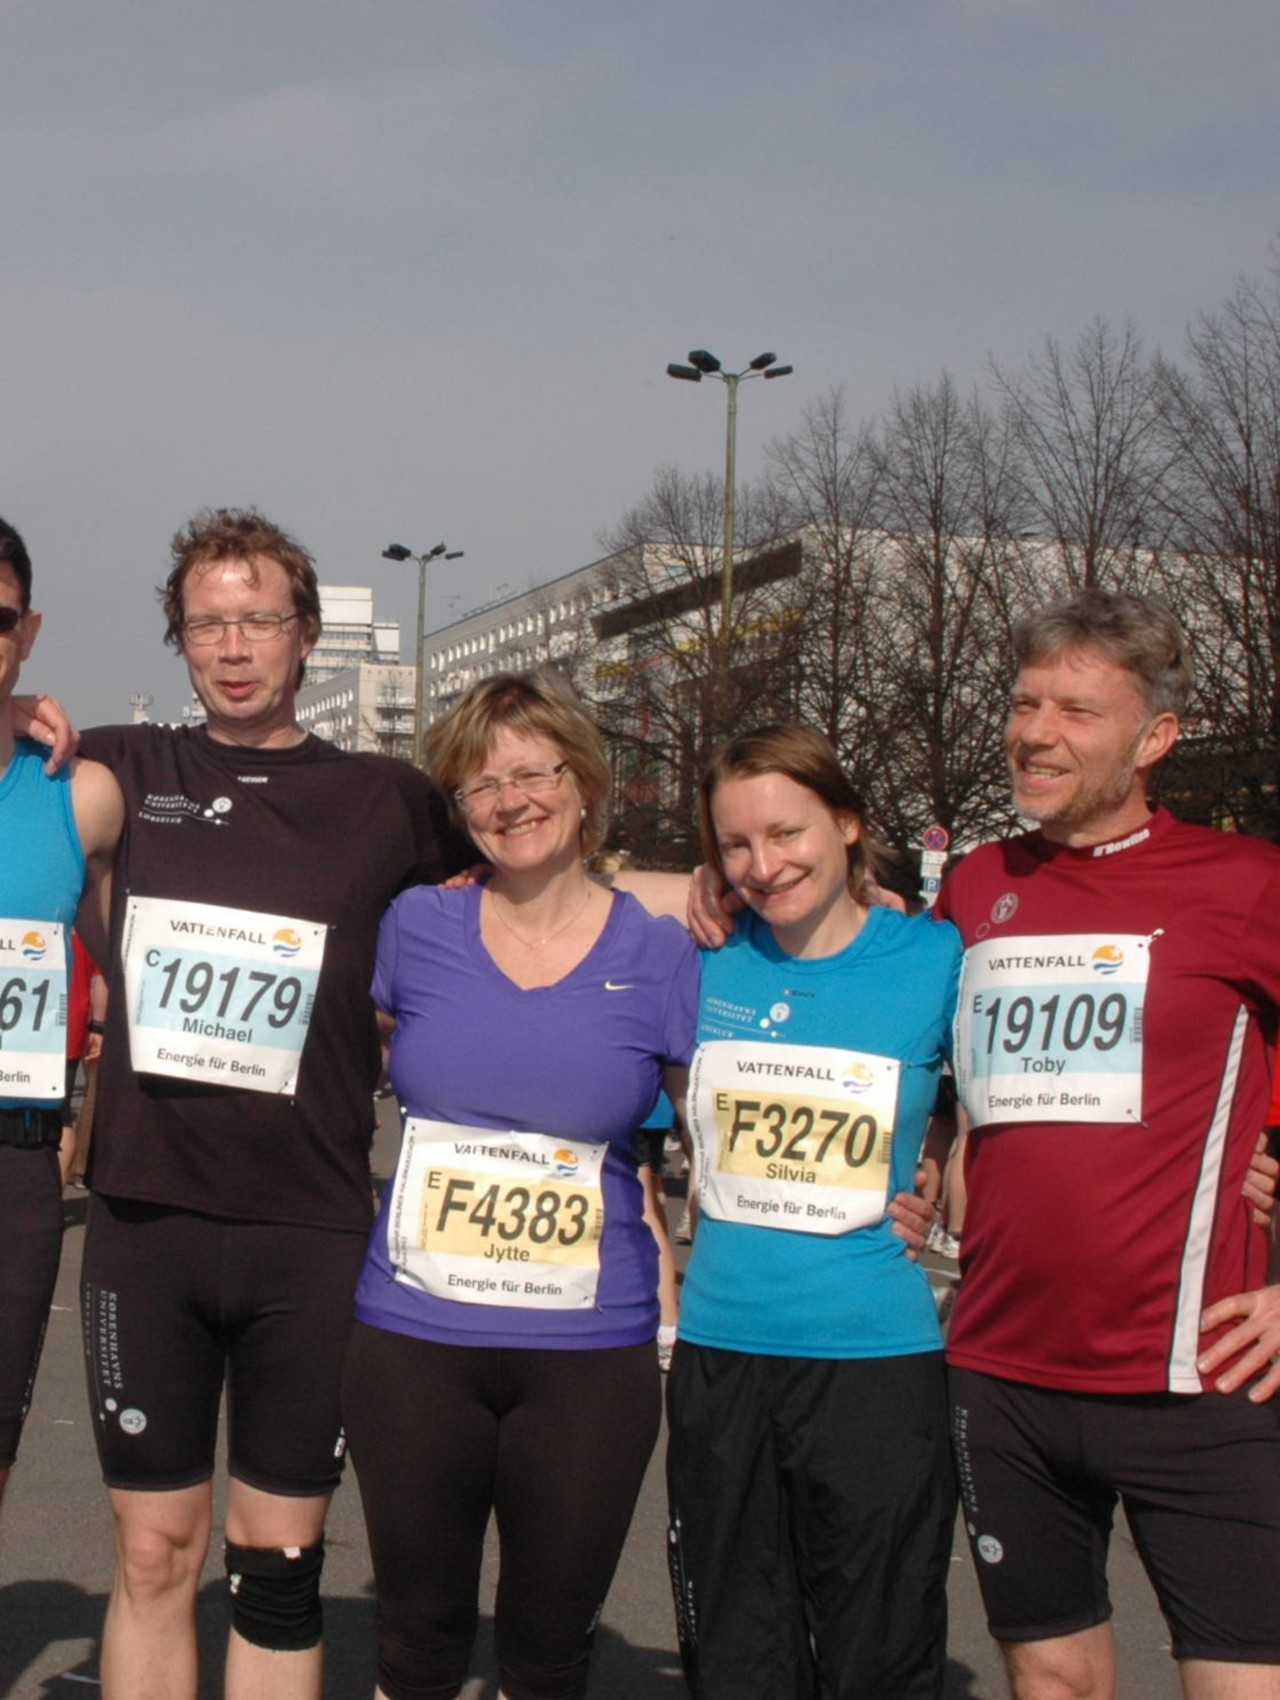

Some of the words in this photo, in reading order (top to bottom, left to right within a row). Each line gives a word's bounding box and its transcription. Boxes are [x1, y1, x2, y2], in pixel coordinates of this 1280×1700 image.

[170, 919, 267, 945] VATTENFALL
[146, 949, 161, 968] C
[989, 955, 1086, 971] VATTENFALL
[159, 957, 302, 1029] 19179
[973, 994, 983, 1014] E
[182, 1017, 253, 1043] Michael
[984, 993, 1127, 1055] 19109
[157, 1048, 205, 1068] Energie
[209, 1057, 227, 1070] für
[230, 1060, 267, 1077] Berlin
[736, 1060, 835, 1081] VATTENFALL
[1021, 1056, 1066, 1076] Toby
[716, 1093, 730, 1111] E
[989, 1094, 1033, 1109] Energie
[1037, 1093, 1055, 1106] für
[1060, 1092, 1101, 1107] Berlin
[728, 1100, 877, 1168] F3270
[454, 1143, 550, 1166] VATTENFALL
[428, 1170, 442, 1189] E
[766, 1163, 816, 1184] Silvia
[436, 1178, 589, 1246] F4383
[736, 1195, 780, 1214] Energie
[783, 1200, 802, 1215] für
[806, 1202, 846, 1220] Berlin
[484, 1243, 530, 1264] Jytte
[447, 1274, 497, 1292] Energie
[501, 1279, 520, 1293] für
[524, 1280, 562, 1295] Berlin
[100, 1290, 111, 1386] UNIVERSITET
[108, 1292, 123, 1390] KØBENHAVNS
